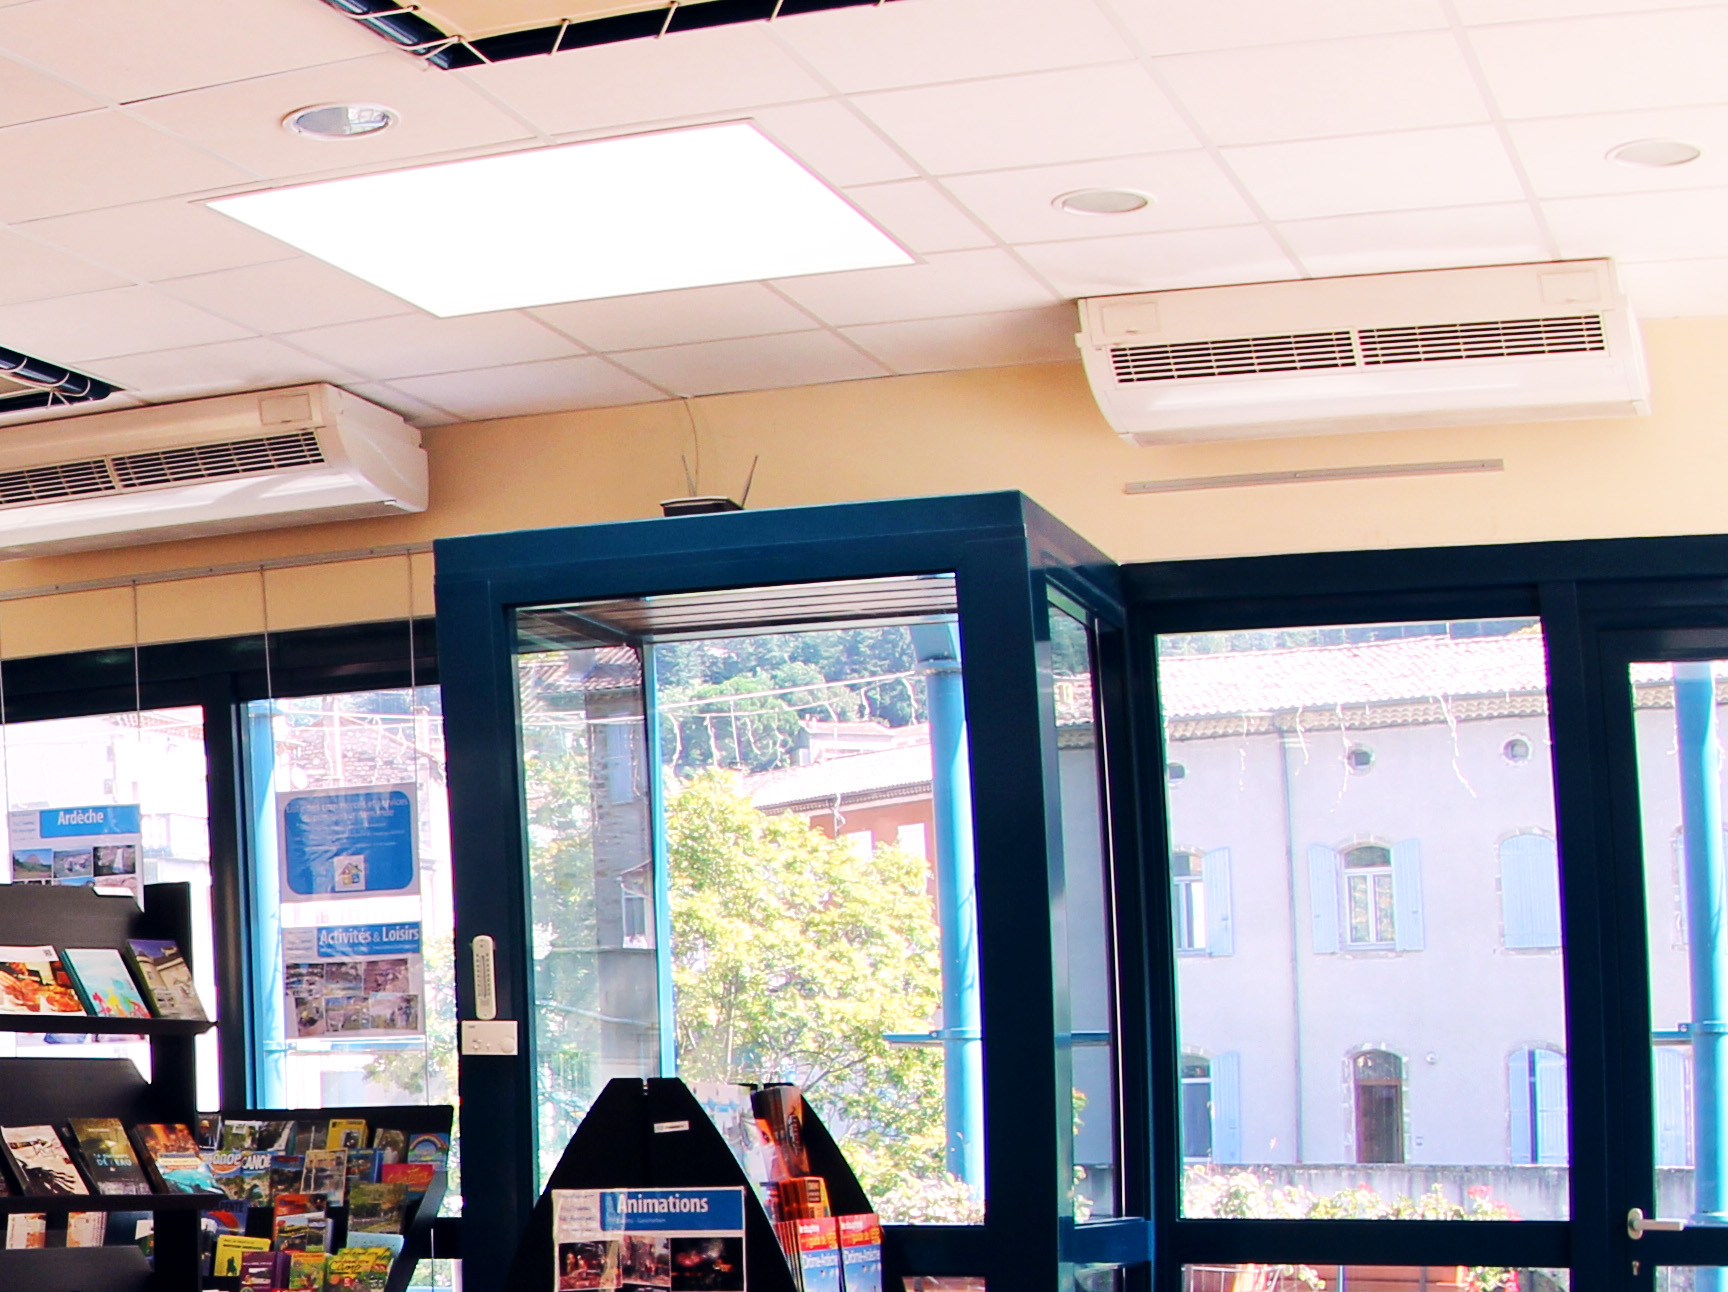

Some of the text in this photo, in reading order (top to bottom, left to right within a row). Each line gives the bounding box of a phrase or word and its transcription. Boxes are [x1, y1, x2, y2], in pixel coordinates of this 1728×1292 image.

[57, 808, 104, 825] Ardèche
[318, 927, 372, 945] Activités
[382, 925, 420, 942] Loisirs
[617, 1193, 709, 1214] Animations
